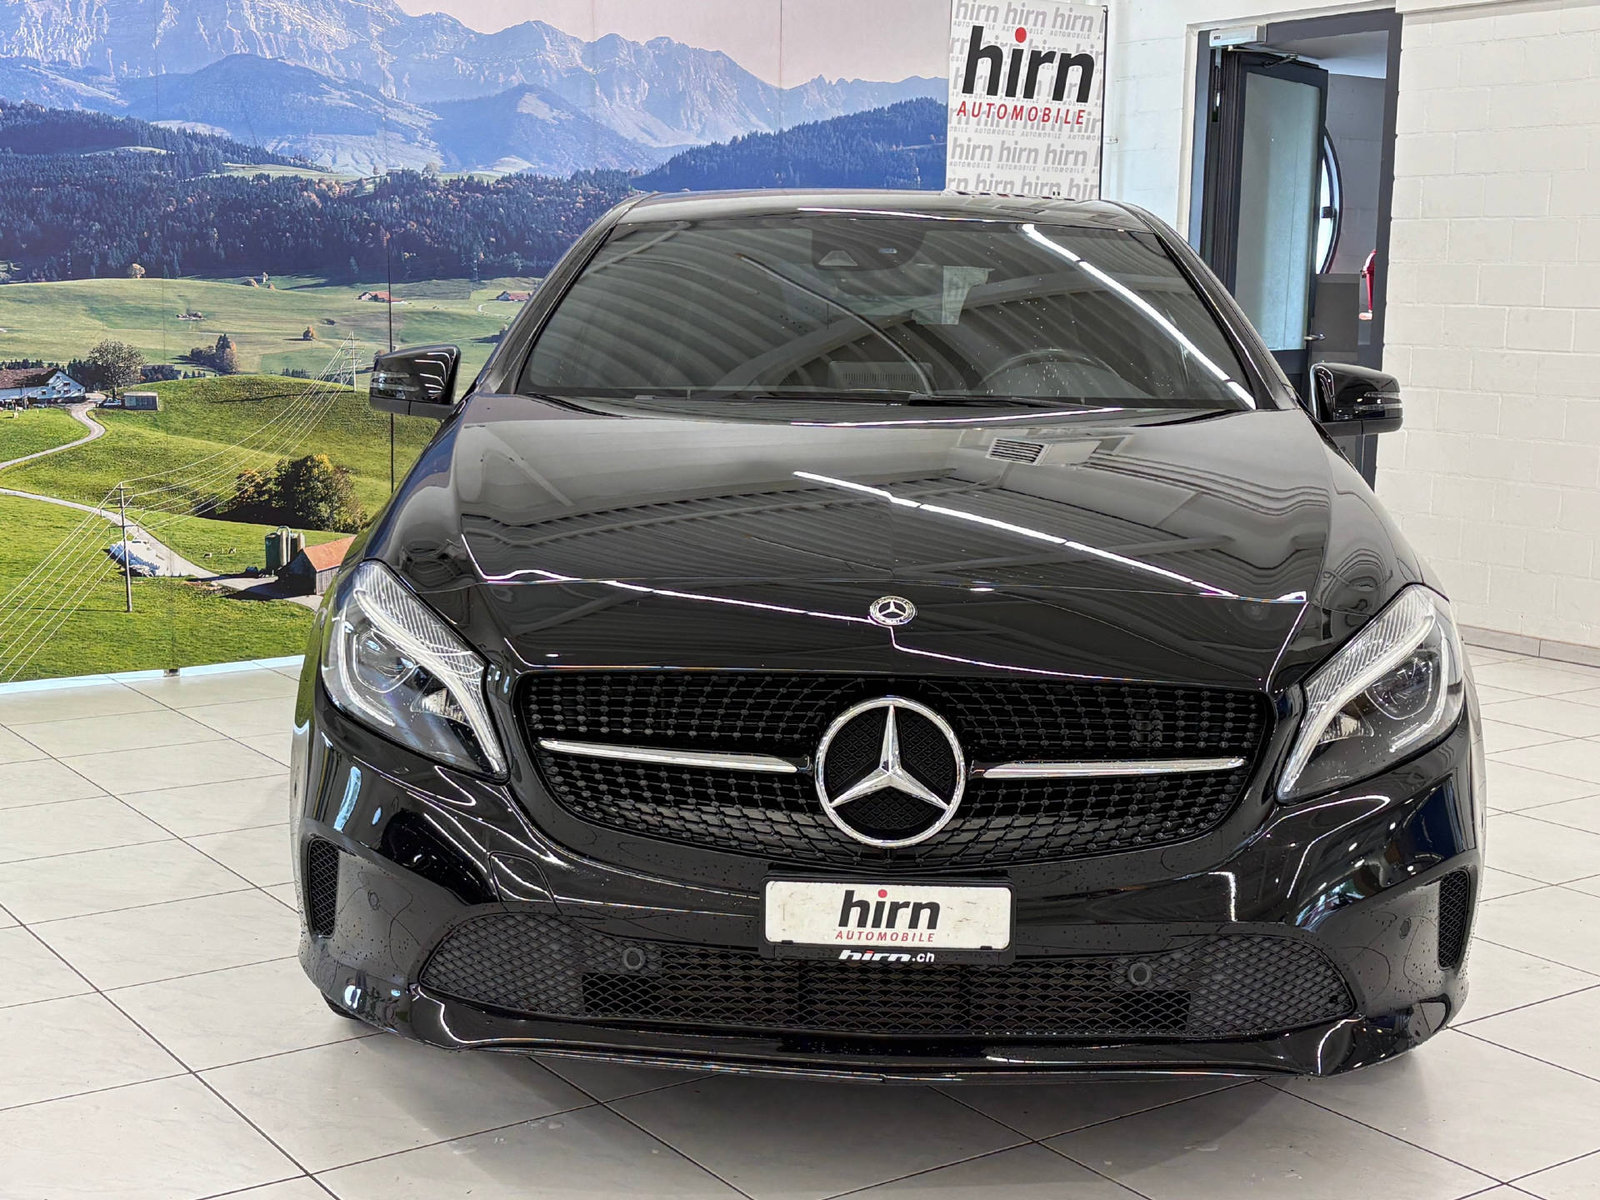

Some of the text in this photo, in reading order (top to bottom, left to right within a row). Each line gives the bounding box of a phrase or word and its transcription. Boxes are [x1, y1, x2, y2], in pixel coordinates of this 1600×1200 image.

[955, 0, 999, 23] hirn
[1004, 1, 1047, 28] hirn
[1052, 7, 1094, 33] hirn
[962, 25, 1095, 103] hirn
[957, 100, 1085, 125] AUTOMOBILE
[951, 137, 1088, 167] hirn hirn hirn
[838, 889, 940, 930] hirn
[835, 930, 935, 942] AUTOMOBILE
[838, 949, 935, 962] hirn.ch
